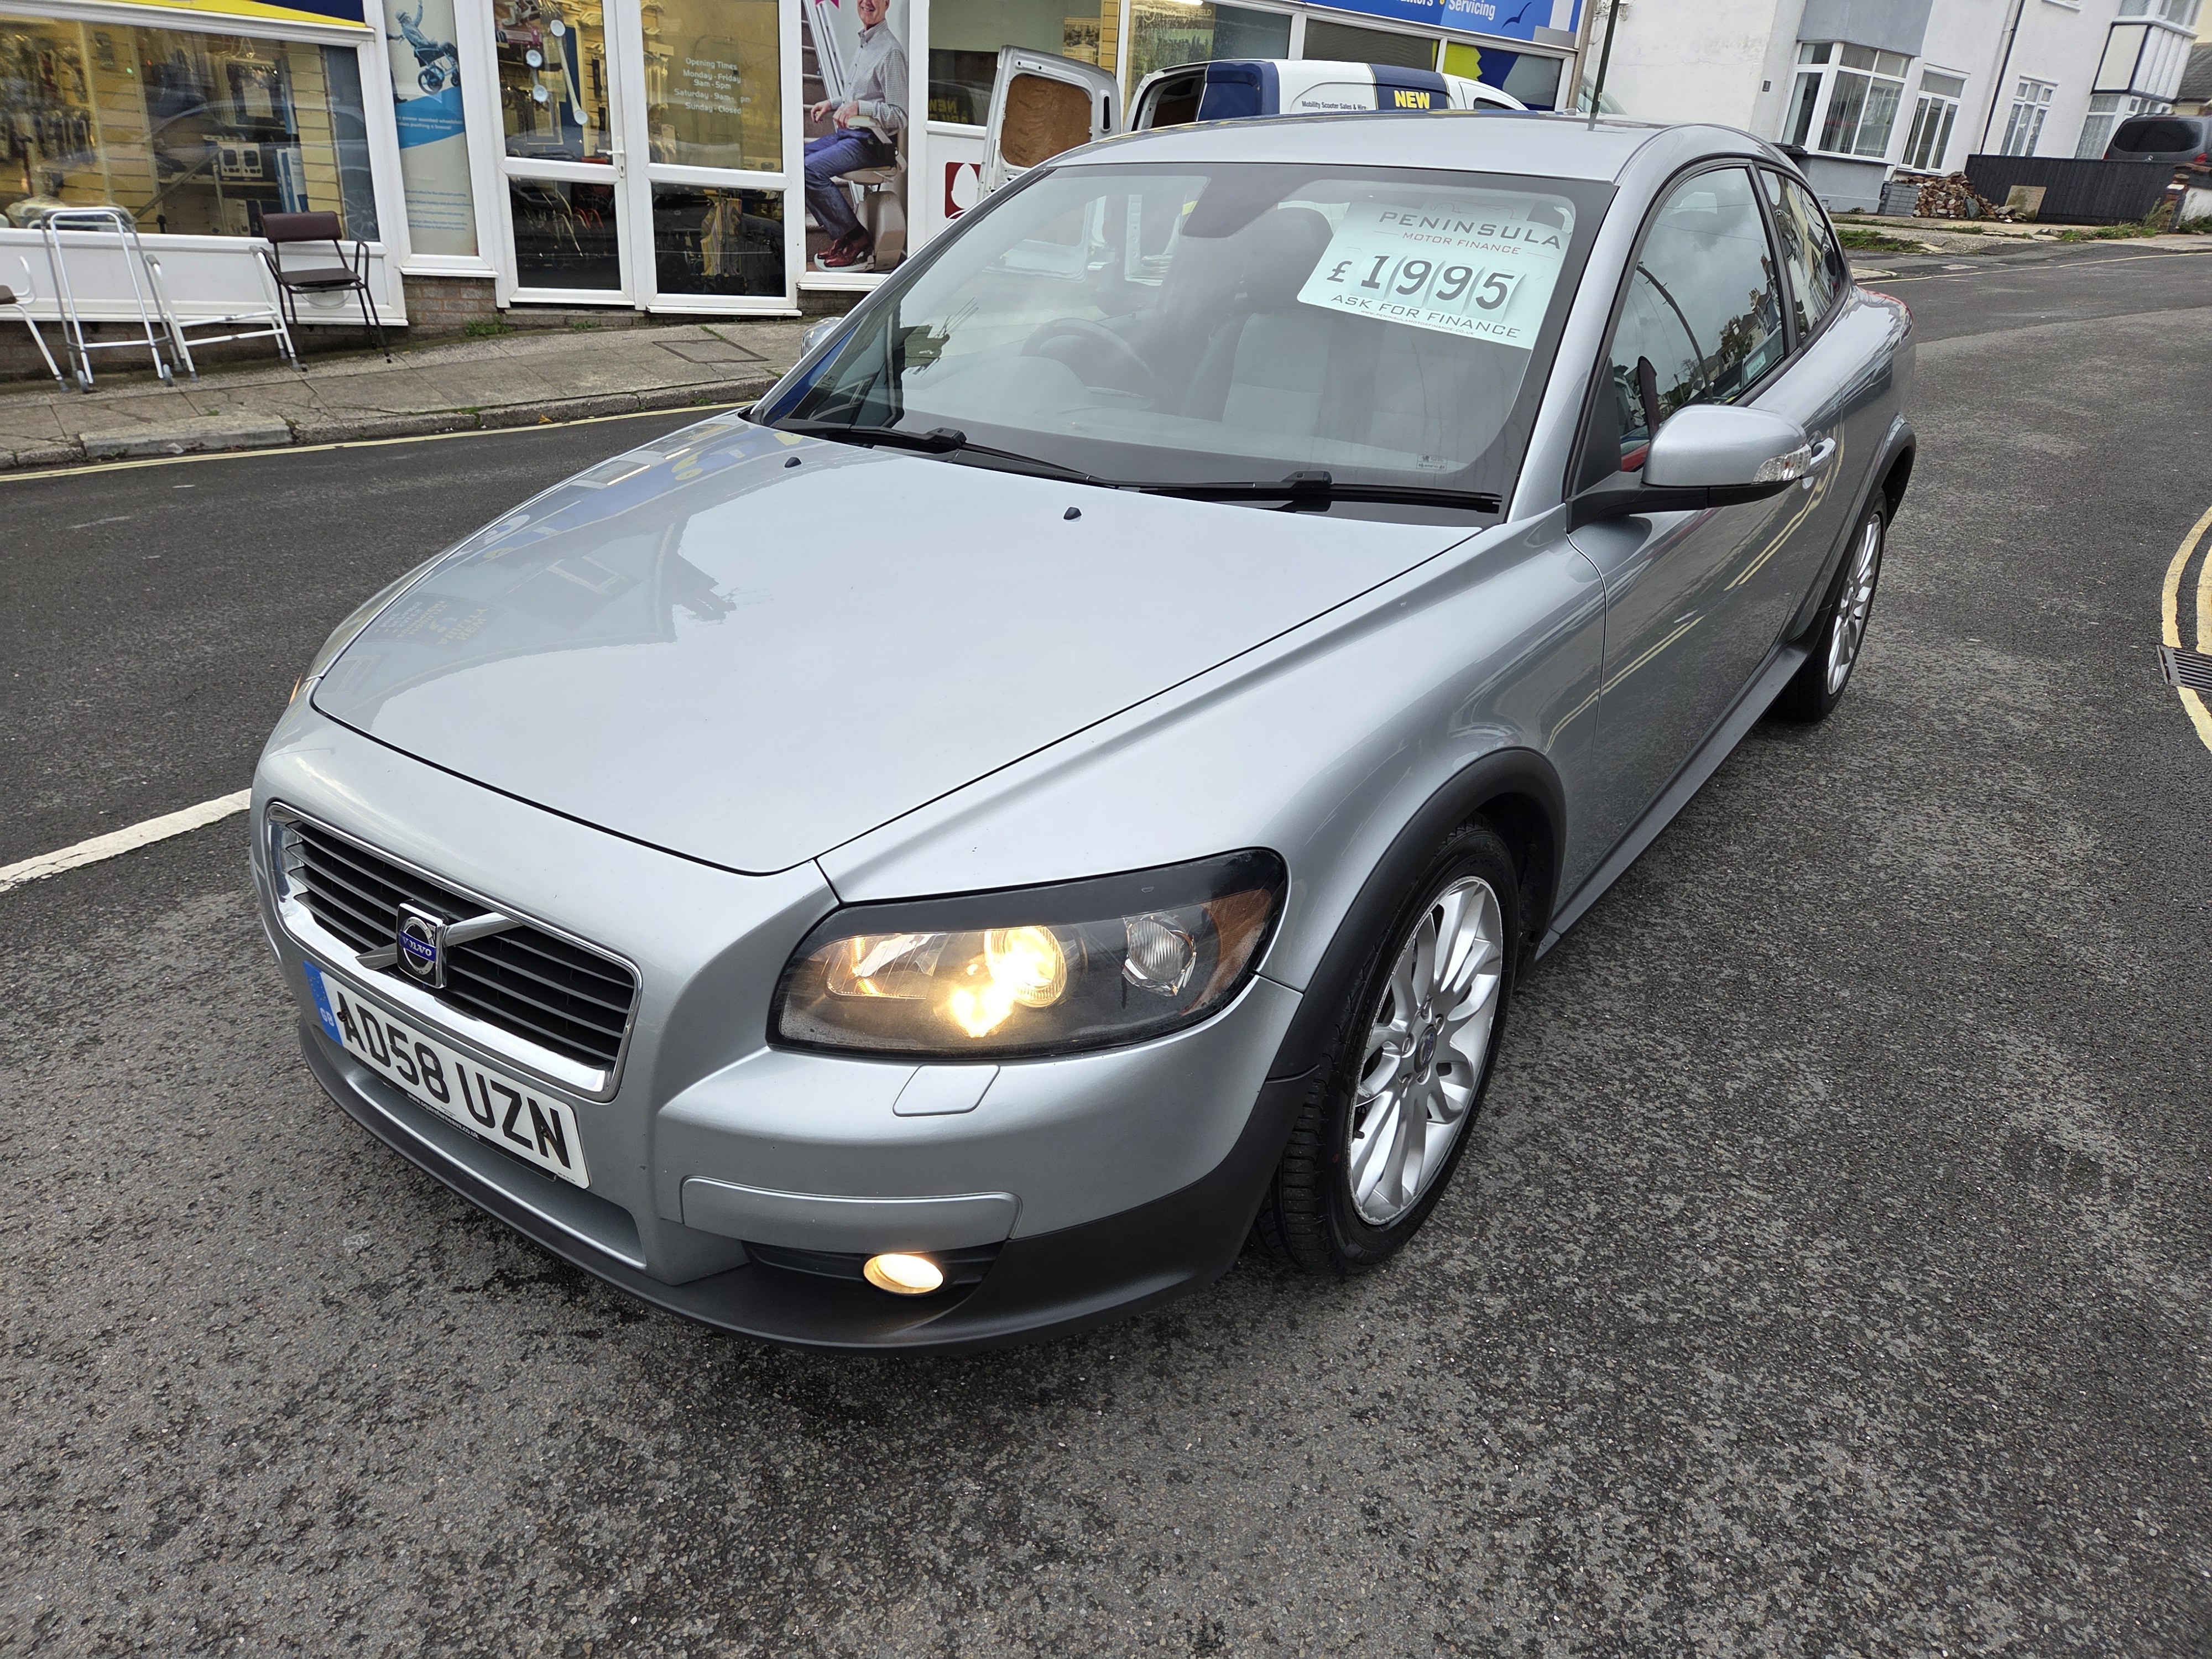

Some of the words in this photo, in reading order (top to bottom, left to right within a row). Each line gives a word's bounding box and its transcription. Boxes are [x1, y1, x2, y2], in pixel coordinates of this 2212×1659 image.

[1448, 0, 1496, 21] Servicing
[685, 57, 716, 69] Opening
[716, 61, 738, 70] Times
[683, 69, 713, 80] Monday
[717, 73, 742, 84] Friday
[694, 79, 711, 87] 9am
[715, 81, 732, 90] 5pm
[674, 88, 709, 100] Saturday
[1394, 90, 1430, 109] NEW
[685, 102, 713, 113] Sunday
[718, 105, 742, 114] Closed
[1302, 100, 1321, 109] Mobility
[1379, 211, 1561, 250] PENINSULA
[1402, 232, 1452, 246] MOTOR
[1457, 239, 1521, 255] FINANCE
[1331, 294, 1373, 309] ASK
[1379, 303, 1420, 319] FOR
[1427, 312, 1521, 338] FINANCE
[401, 935, 432, 957] VOLVO
[320, 1007, 335, 1027] GB
[337, 990, 451, 1104] AD58
[455, 1061, 572, 1170] UZN
